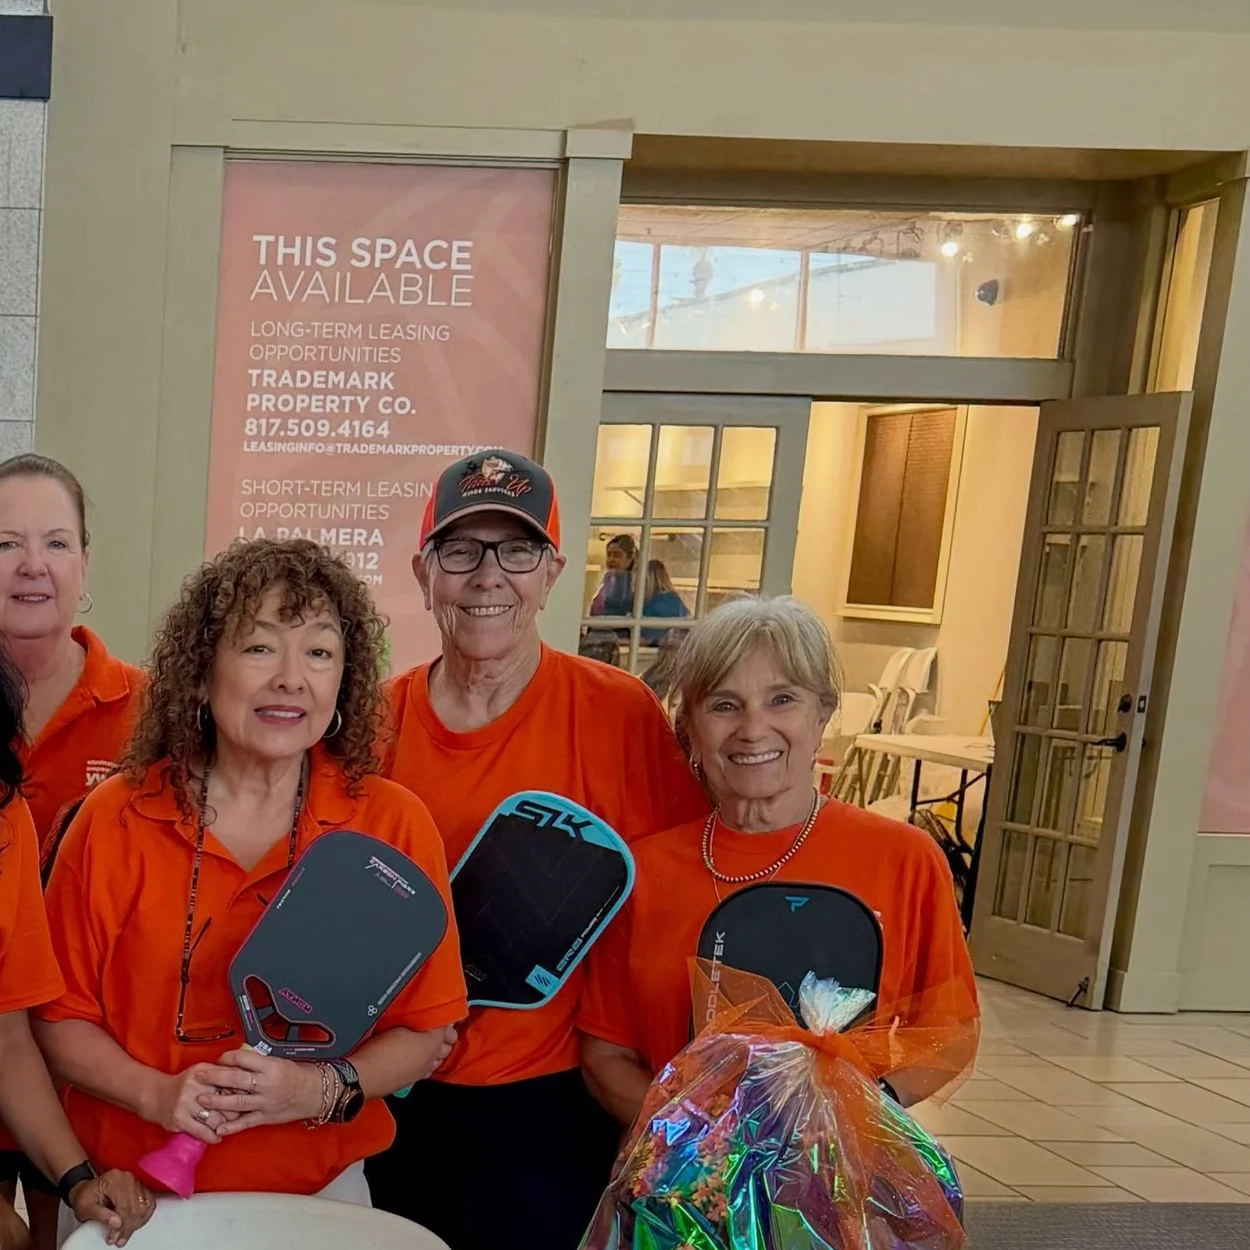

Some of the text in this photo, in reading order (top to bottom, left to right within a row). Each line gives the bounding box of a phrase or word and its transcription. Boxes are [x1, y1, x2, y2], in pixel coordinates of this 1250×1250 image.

[252, 235, 473, 271] THIS SPACE
[250, 270, 474, 307] AVAILABLE
[250, 320, 450, 342] LONG-TERM LEASING
[249, 344, 401, 364] OPPORTUNITIES
[248, 369, 395, 391] TRADEMARK
[247, 394, 417, 415] PROPERTY CO.
[245, 418, 390, 440] 817.509.4164
[243, 441, 504, 457] LEASINGINFO@TRADEMARKPROPERTY.C
[241, 479, 432, 498] SHORT-TERM LEASIN
[240, 502, 390, 522] OPPORTUNITIES
[705, 931, 726, 1024] DDLETEK
